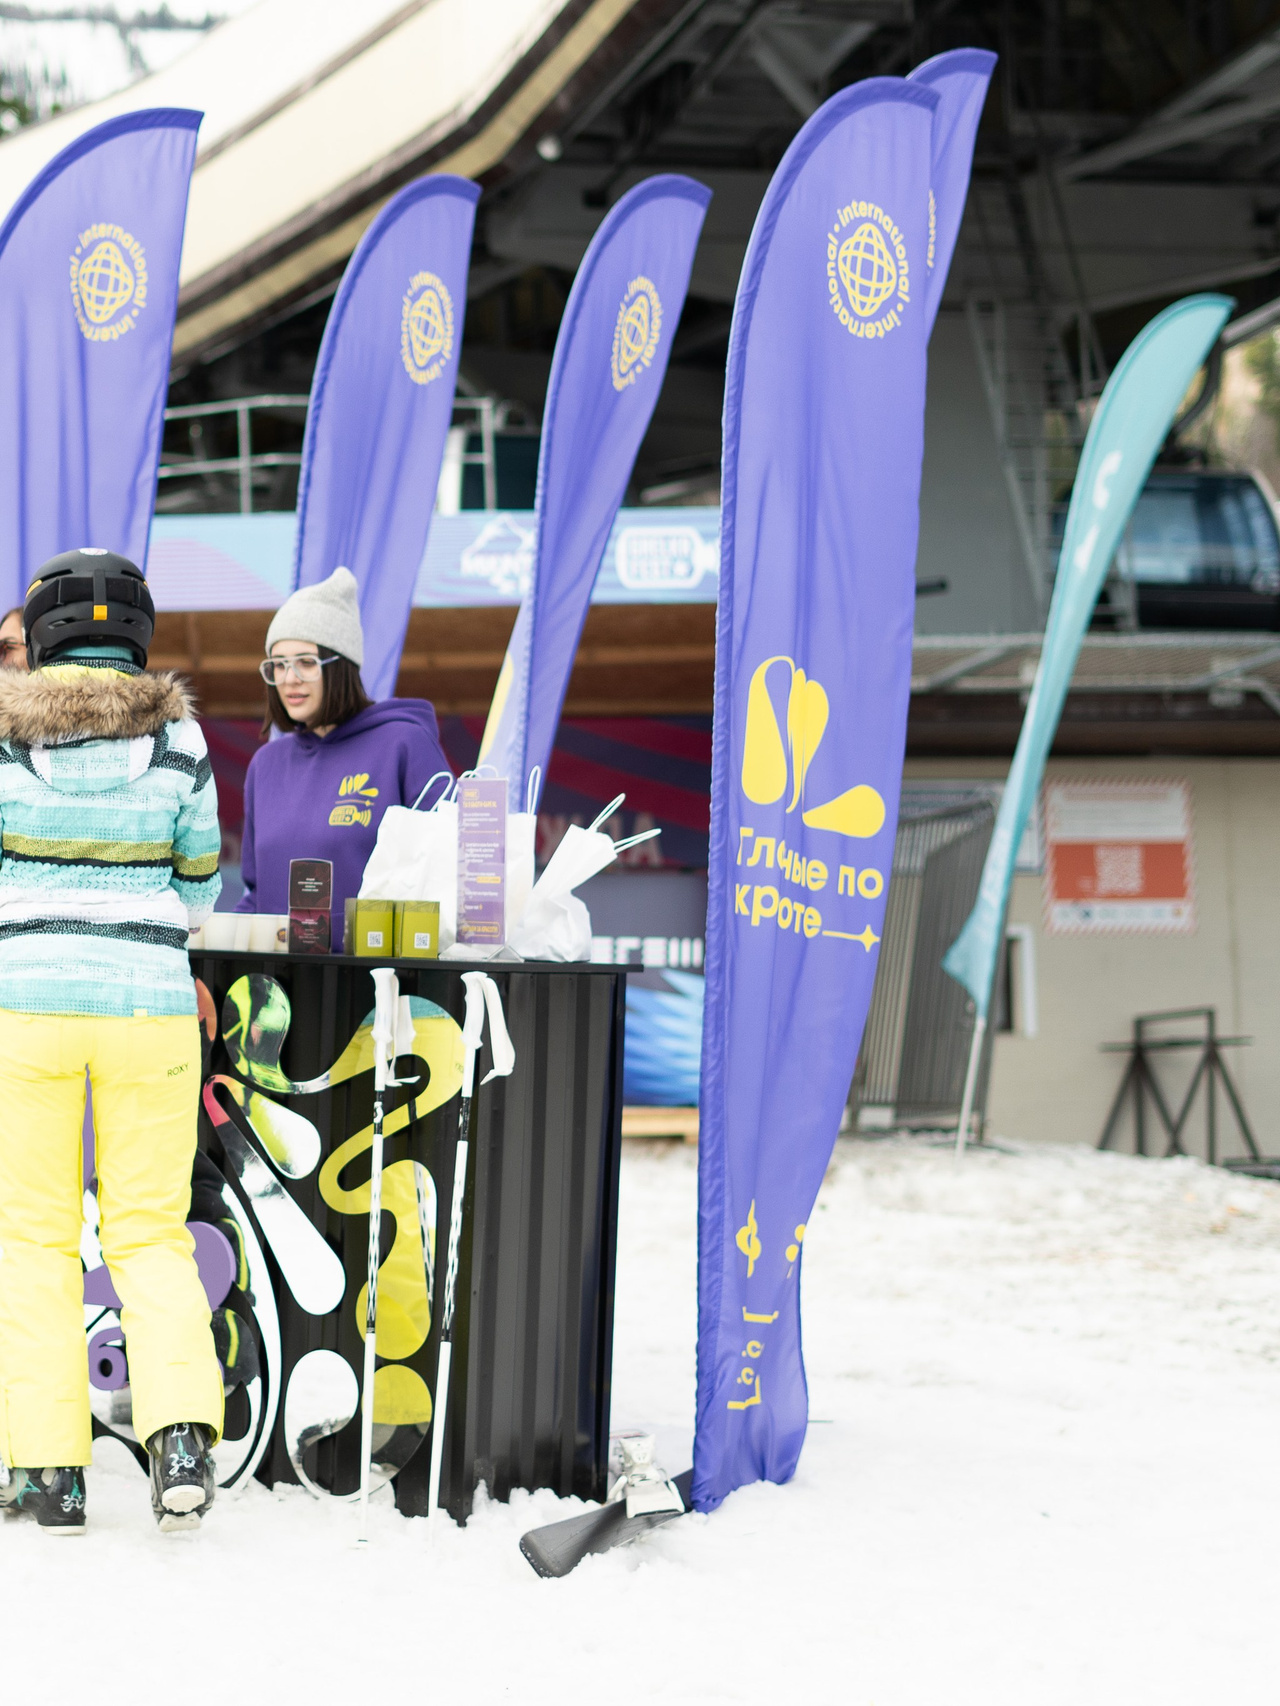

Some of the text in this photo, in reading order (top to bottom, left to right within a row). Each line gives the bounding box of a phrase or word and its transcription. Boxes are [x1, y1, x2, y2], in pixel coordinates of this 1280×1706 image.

[827, 233, 902, 338] international
[837, 201, 910, 303] international
[837, 864, 885, 900] по
[167, 1062, 189, 1077] ROXY
